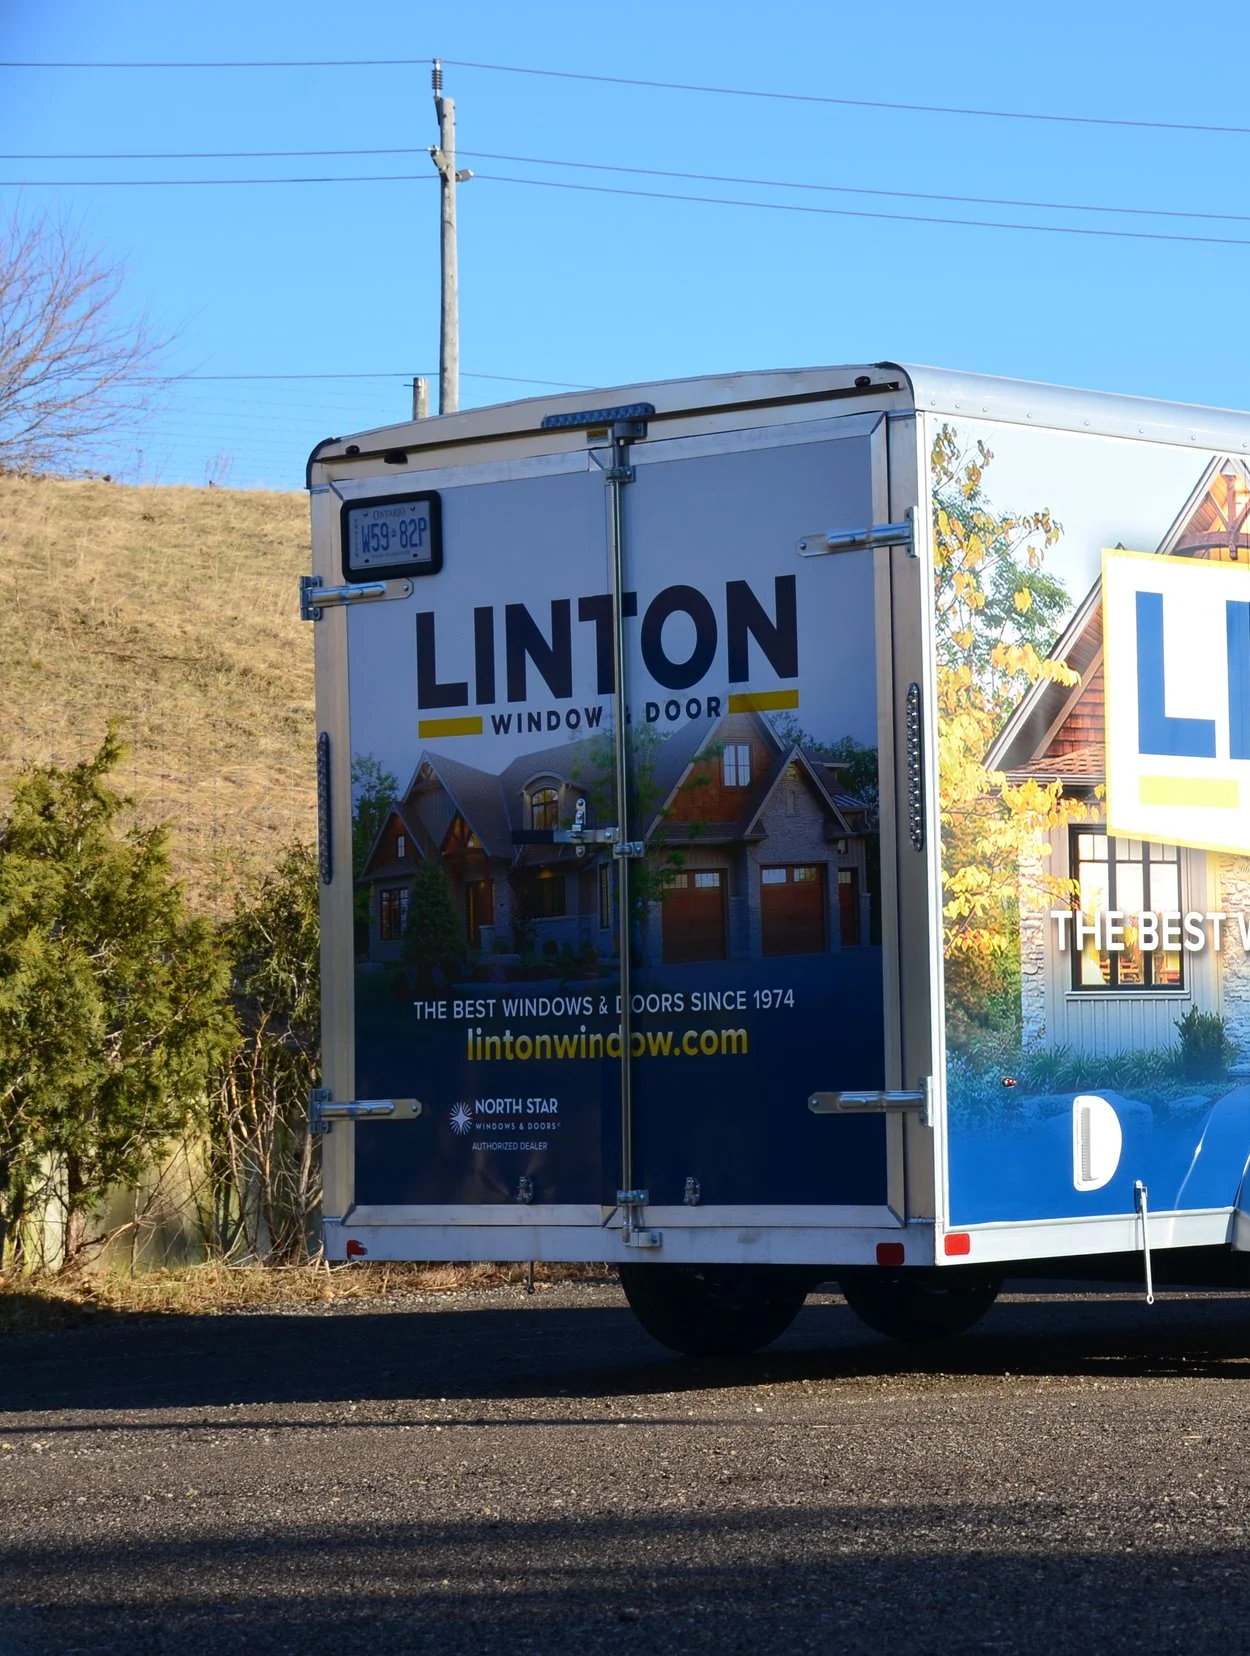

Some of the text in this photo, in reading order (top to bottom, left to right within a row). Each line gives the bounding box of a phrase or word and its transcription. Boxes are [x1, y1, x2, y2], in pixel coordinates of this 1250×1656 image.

[416, 574, 799, 710] LINTON
[491, 705, 603, 735] WINDOW
[645, 696, 721, 723] DOOR
[1050, 910, 1125, 951] THE
[1138, 911, 1225, 952] BEST
[414, 1001, 447, 1020] THE
[453, 999, 496, 1018] BEST
[502, 996, 593, 1017] WINDOWS
[599, 995, 609, 1015] &
[690, 990, 747, 1012] SINCE
[753, 989, 795, 1010] 1974
[467, 1024, 748, 1061] lintonwindow.com
[475, 1098, 558, 1114] NORTH STAR
[475, 1122, 516, 1130] WINDOWS
[519, 1122, 524, 1130] &
[472, 1142, 548, 1151] AUTHORIZED DEALER
